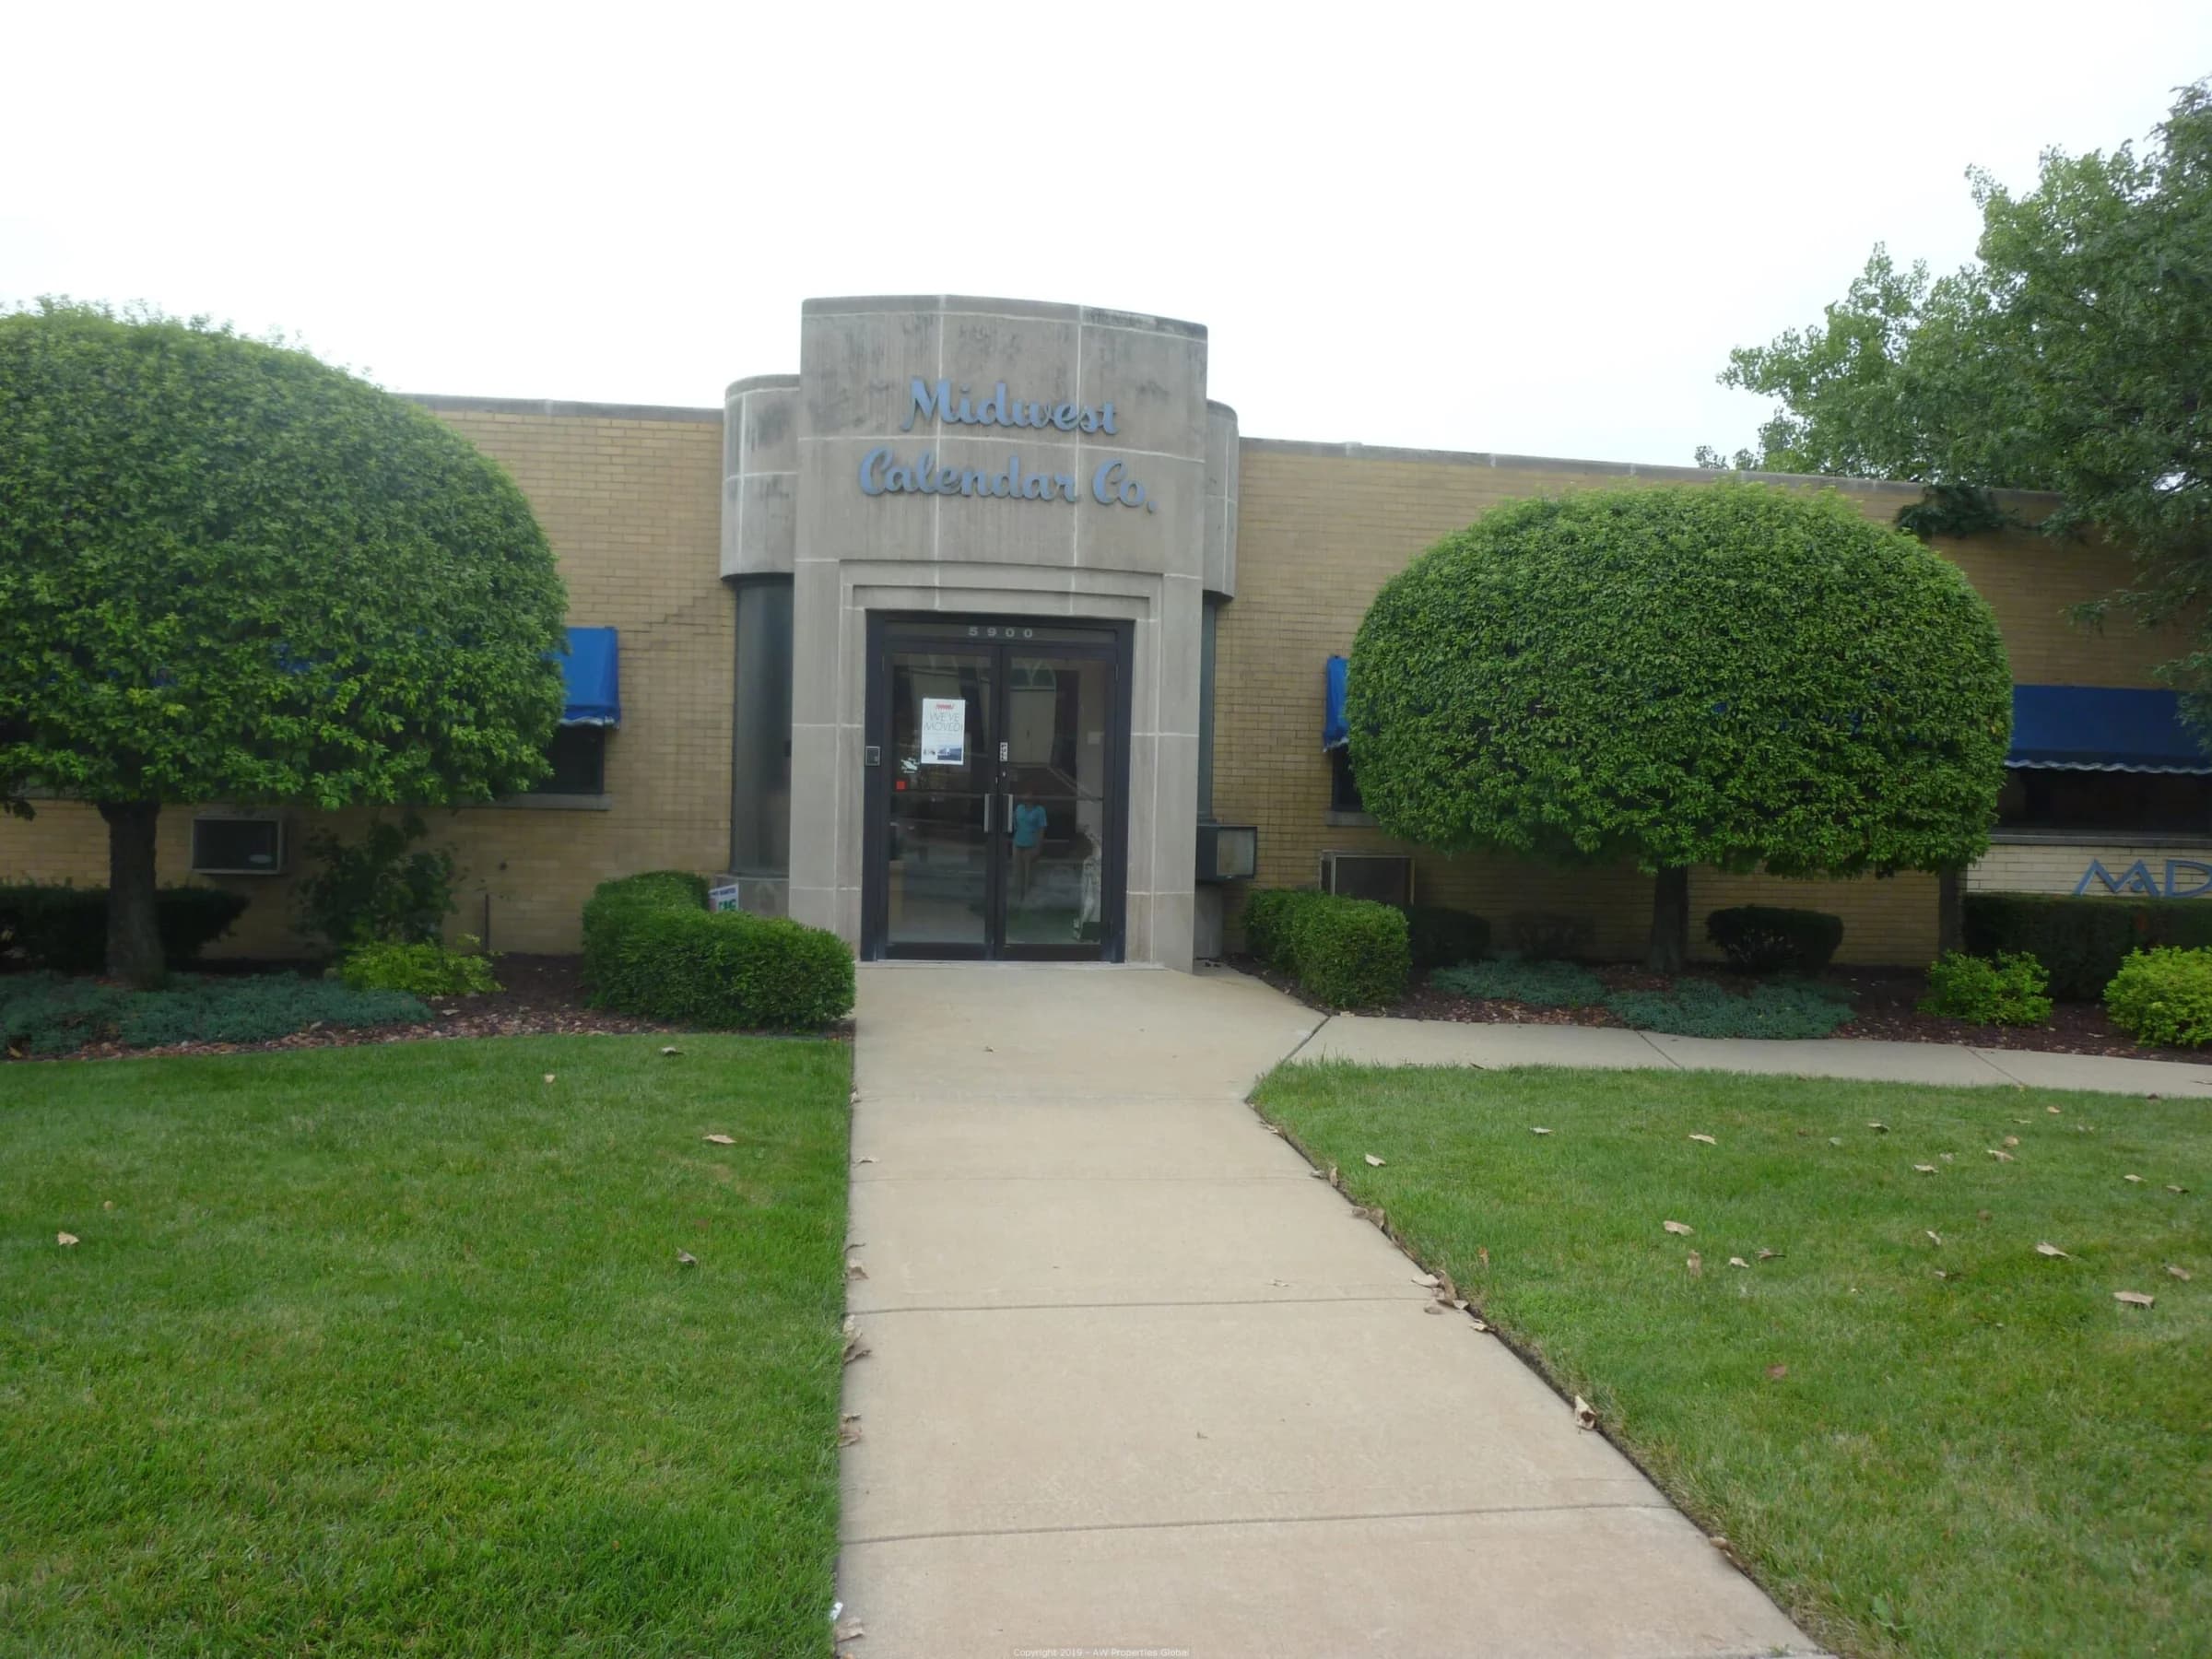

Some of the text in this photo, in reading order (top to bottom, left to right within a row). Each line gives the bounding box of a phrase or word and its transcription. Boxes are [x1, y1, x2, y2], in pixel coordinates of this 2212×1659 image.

[900, 375, 1119, 435] Midwest
[858, 446, 1159, 513] Calendar Co.
[968, 626, 1033, 639] 5900
